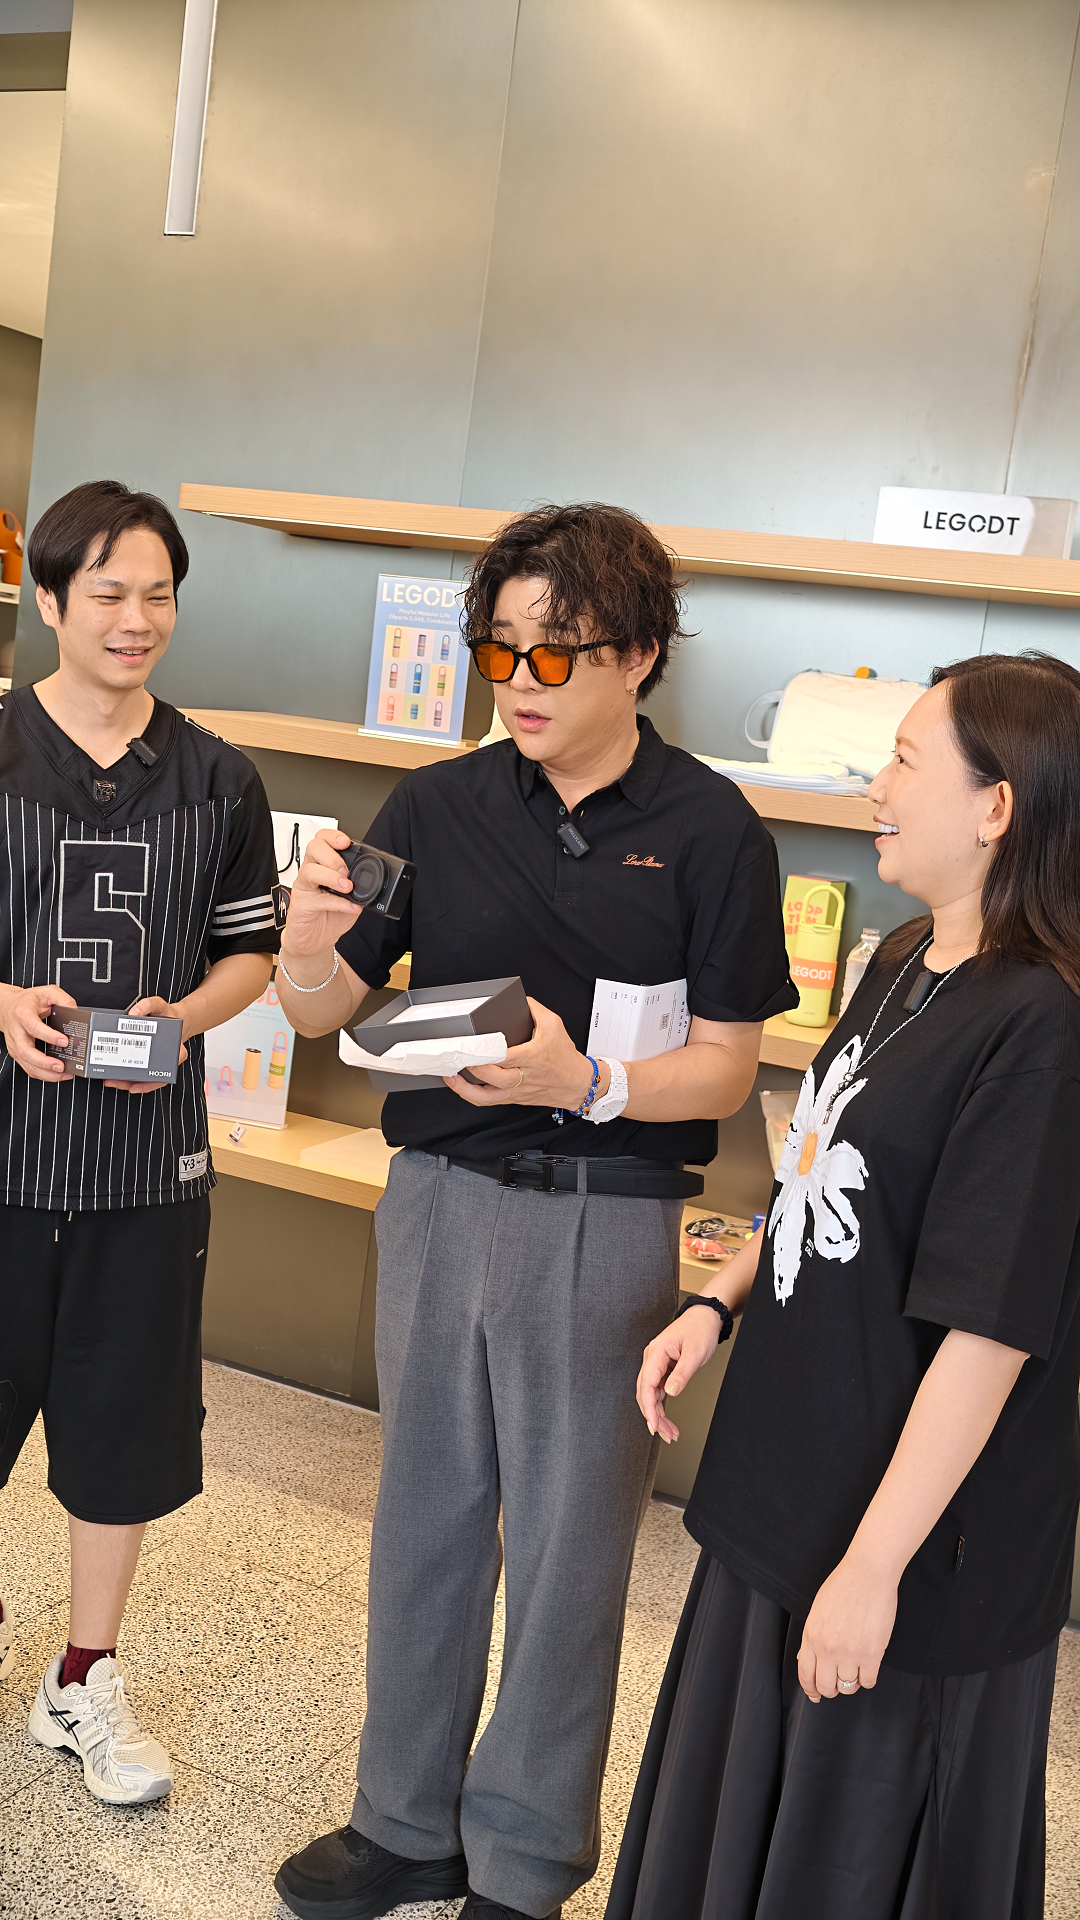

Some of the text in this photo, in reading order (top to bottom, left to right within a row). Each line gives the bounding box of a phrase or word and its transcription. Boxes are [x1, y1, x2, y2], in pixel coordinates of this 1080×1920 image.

[923, 510, 1020, 535] LEGODT
[382, 582, 463, 608] LEGOD
[399, 608, 417, 617] Playful
[418, 610, 440, 618] Modular
[787, 901, 823, 916] LOOP
[55, 840, 150, 1010] 5
[791, 964, 833, 981] LEGODT
[148, 1070, 172, 1078] RICOH
[182, 1158, 195, 1171] Y-3
